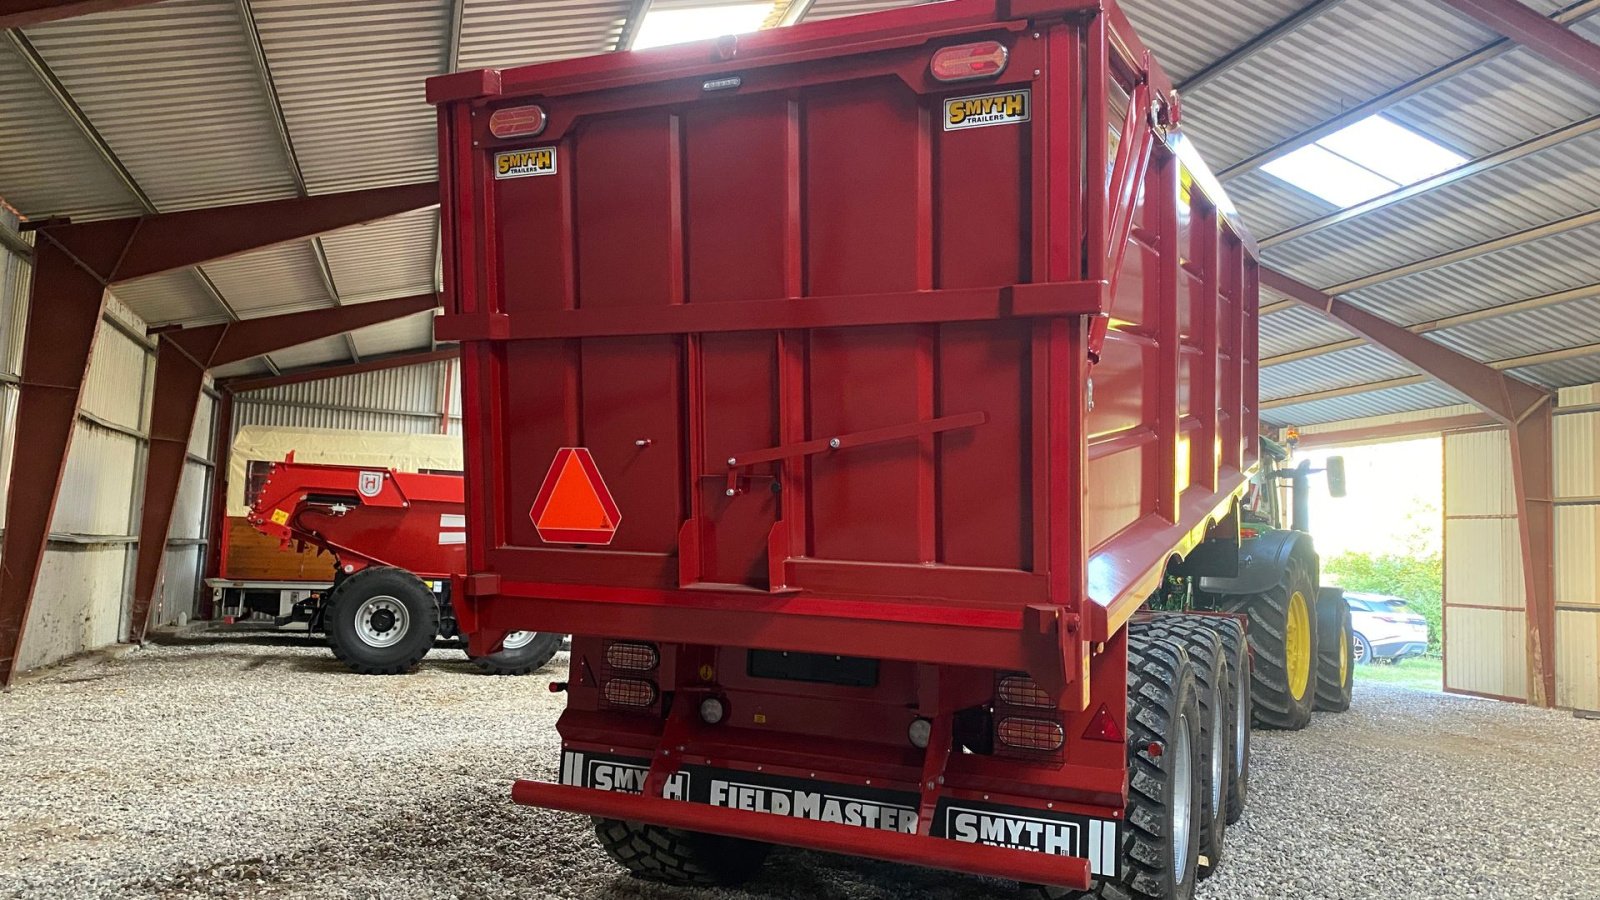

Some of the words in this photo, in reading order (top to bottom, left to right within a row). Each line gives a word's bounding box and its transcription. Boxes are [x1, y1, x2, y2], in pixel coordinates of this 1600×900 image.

[949, 94, 1025, 124] SMYTH
[967, 114, 1004, 124] TRAILERS
[498, 151, 552, 174] SMYTH
[595, 765, 682, 800] SMYH
[955, 813, 1070, 856] SMYTH
